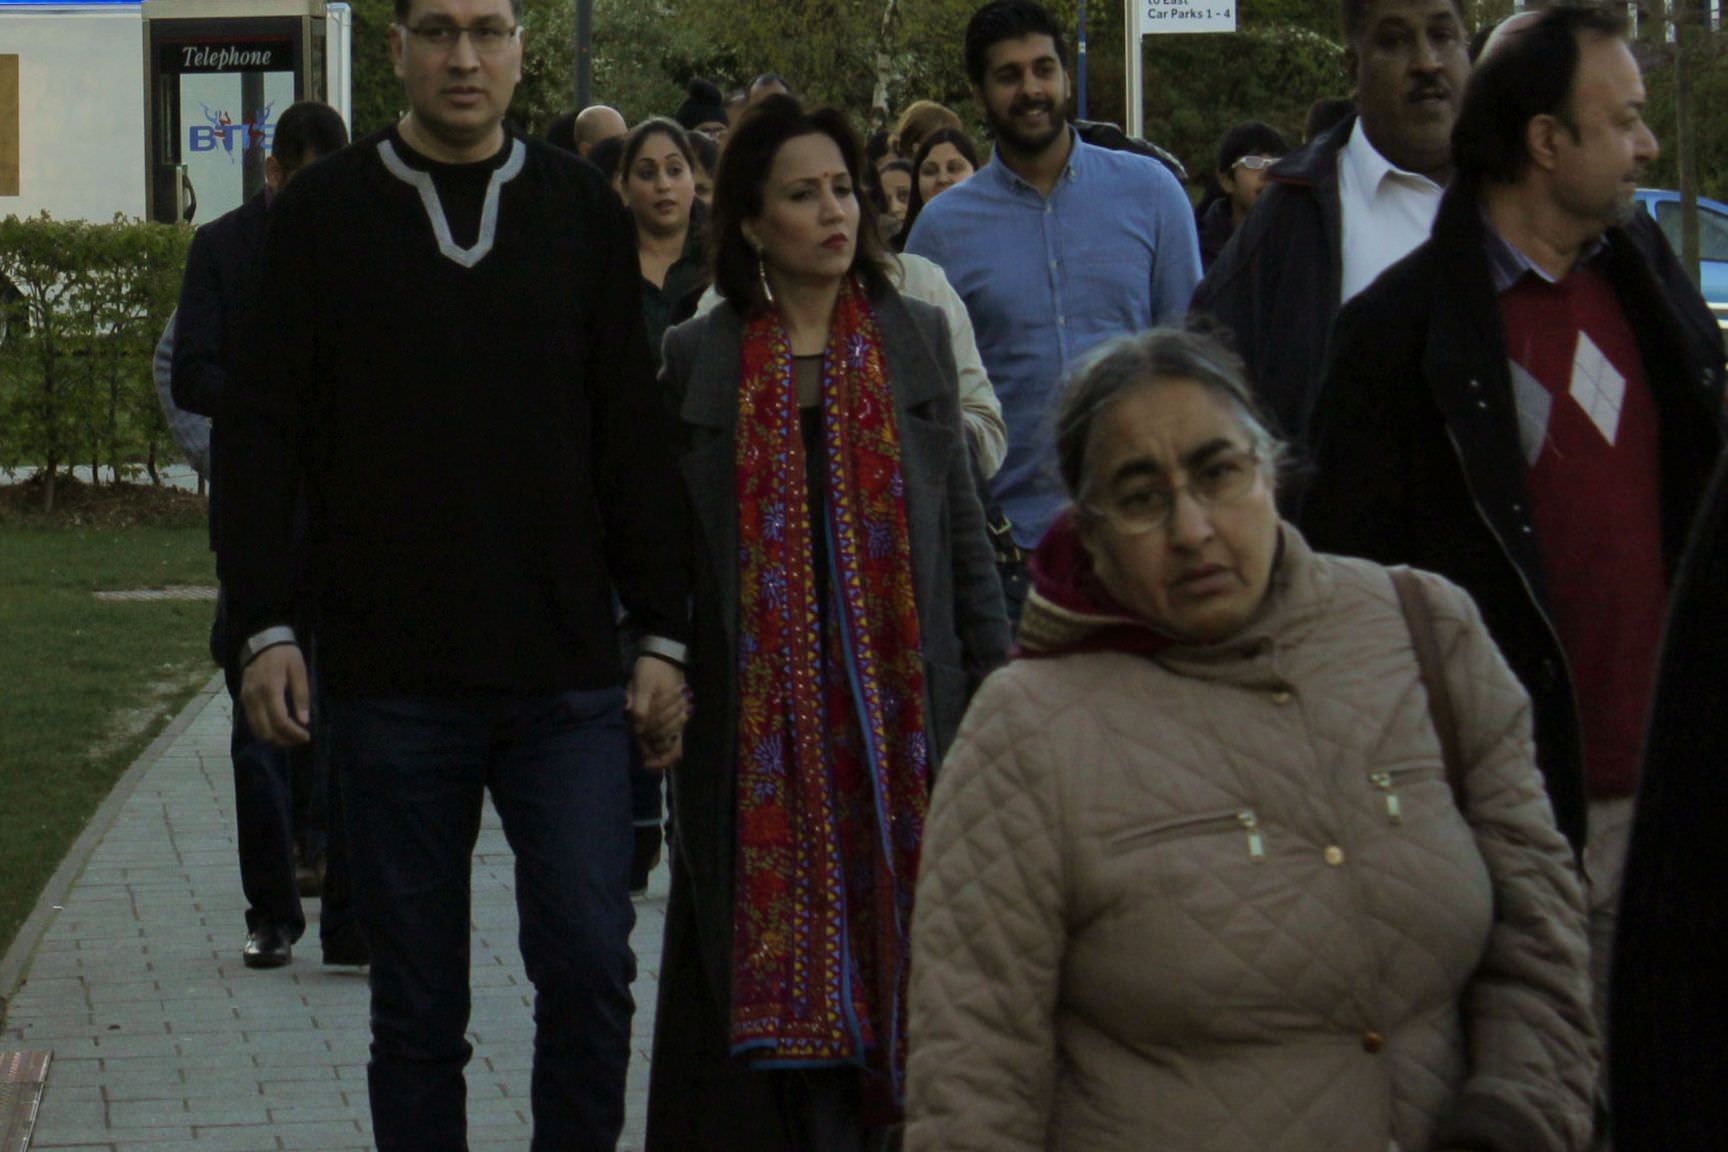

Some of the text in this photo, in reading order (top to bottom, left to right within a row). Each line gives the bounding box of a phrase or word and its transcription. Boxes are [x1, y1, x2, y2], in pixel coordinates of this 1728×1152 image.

[1147, 9, 1168, 19] Car
[1171, 8, 1204, 19] Parks
[1206, 9, 1213, 19] 1
[1223, 8, 1232, 19] 4
[182, 46, 272, 71] Telephone
